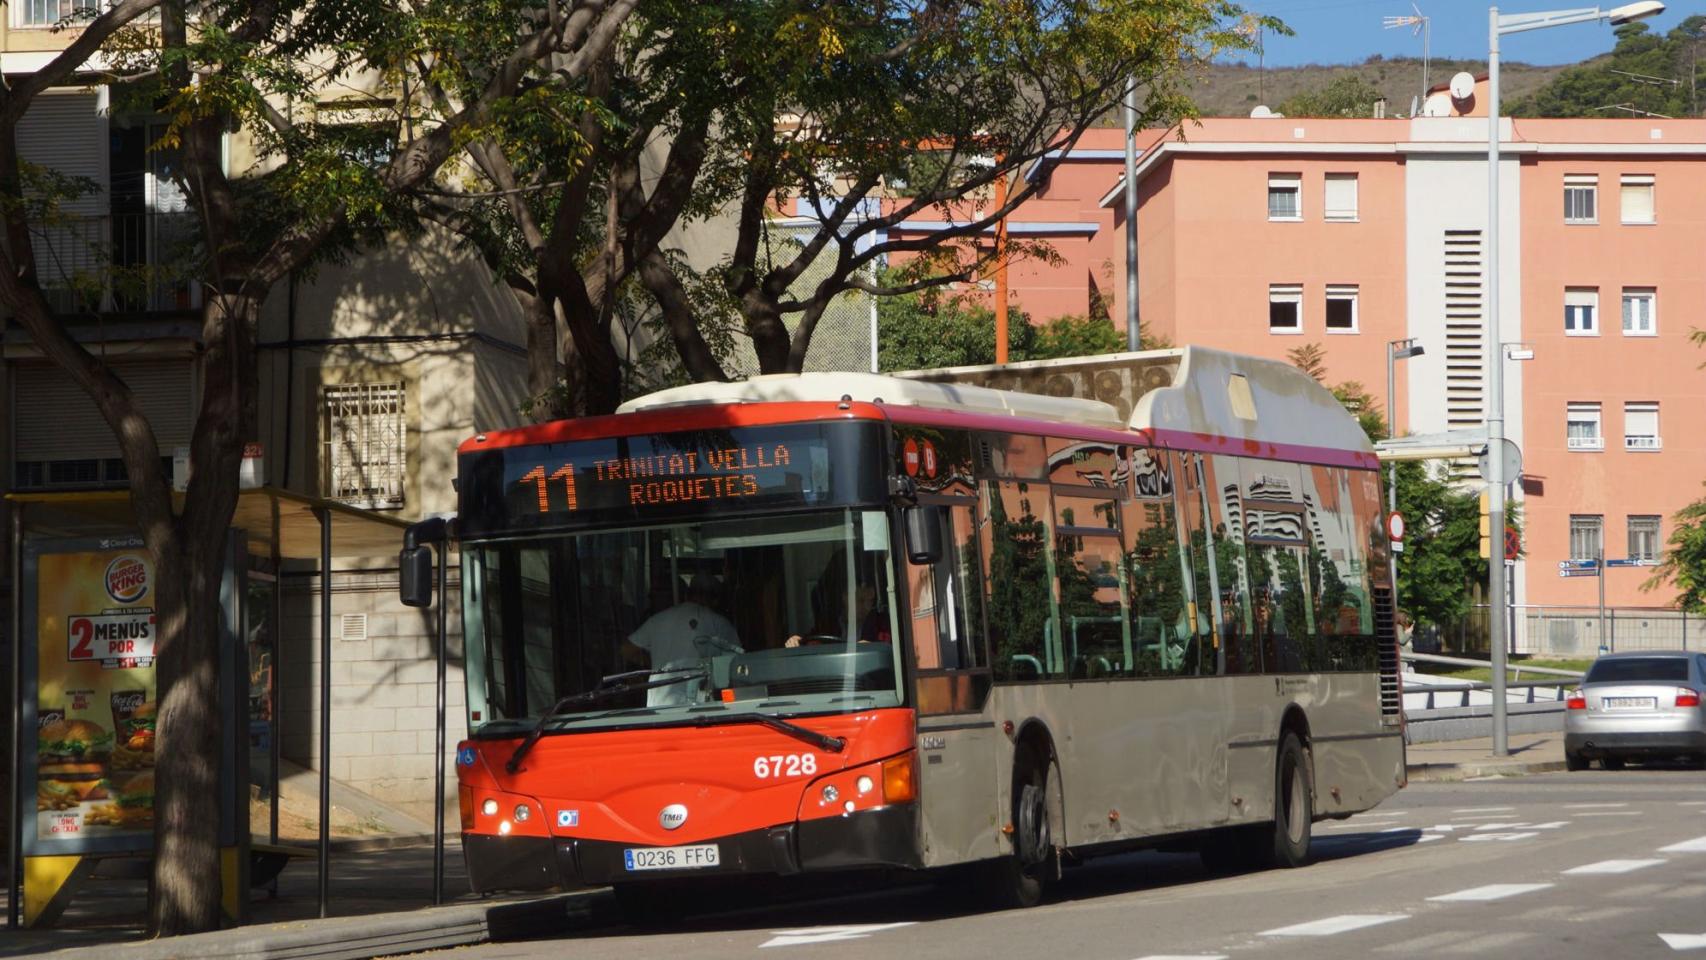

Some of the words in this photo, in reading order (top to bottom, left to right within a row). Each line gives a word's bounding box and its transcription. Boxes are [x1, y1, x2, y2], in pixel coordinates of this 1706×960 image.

[593, 452, 697, 481] TRINITAT
[519, 463, 577, 512] 11
[629, 474, 757, 505] ROQUETES
[110, 563, 145, 581] BURGER
[111, 571, 146, 594] KING
[70, 618, 94, 659] 2
[94, 619, 149, 640] MENÚS
[109, 639, 134, 654] POR
[753, 753, 817, 778] 6728
[663, 813, 683, 822] TMB
[637, 850, 676, 867] 0236
[685, 847, 715, 865] FFG
